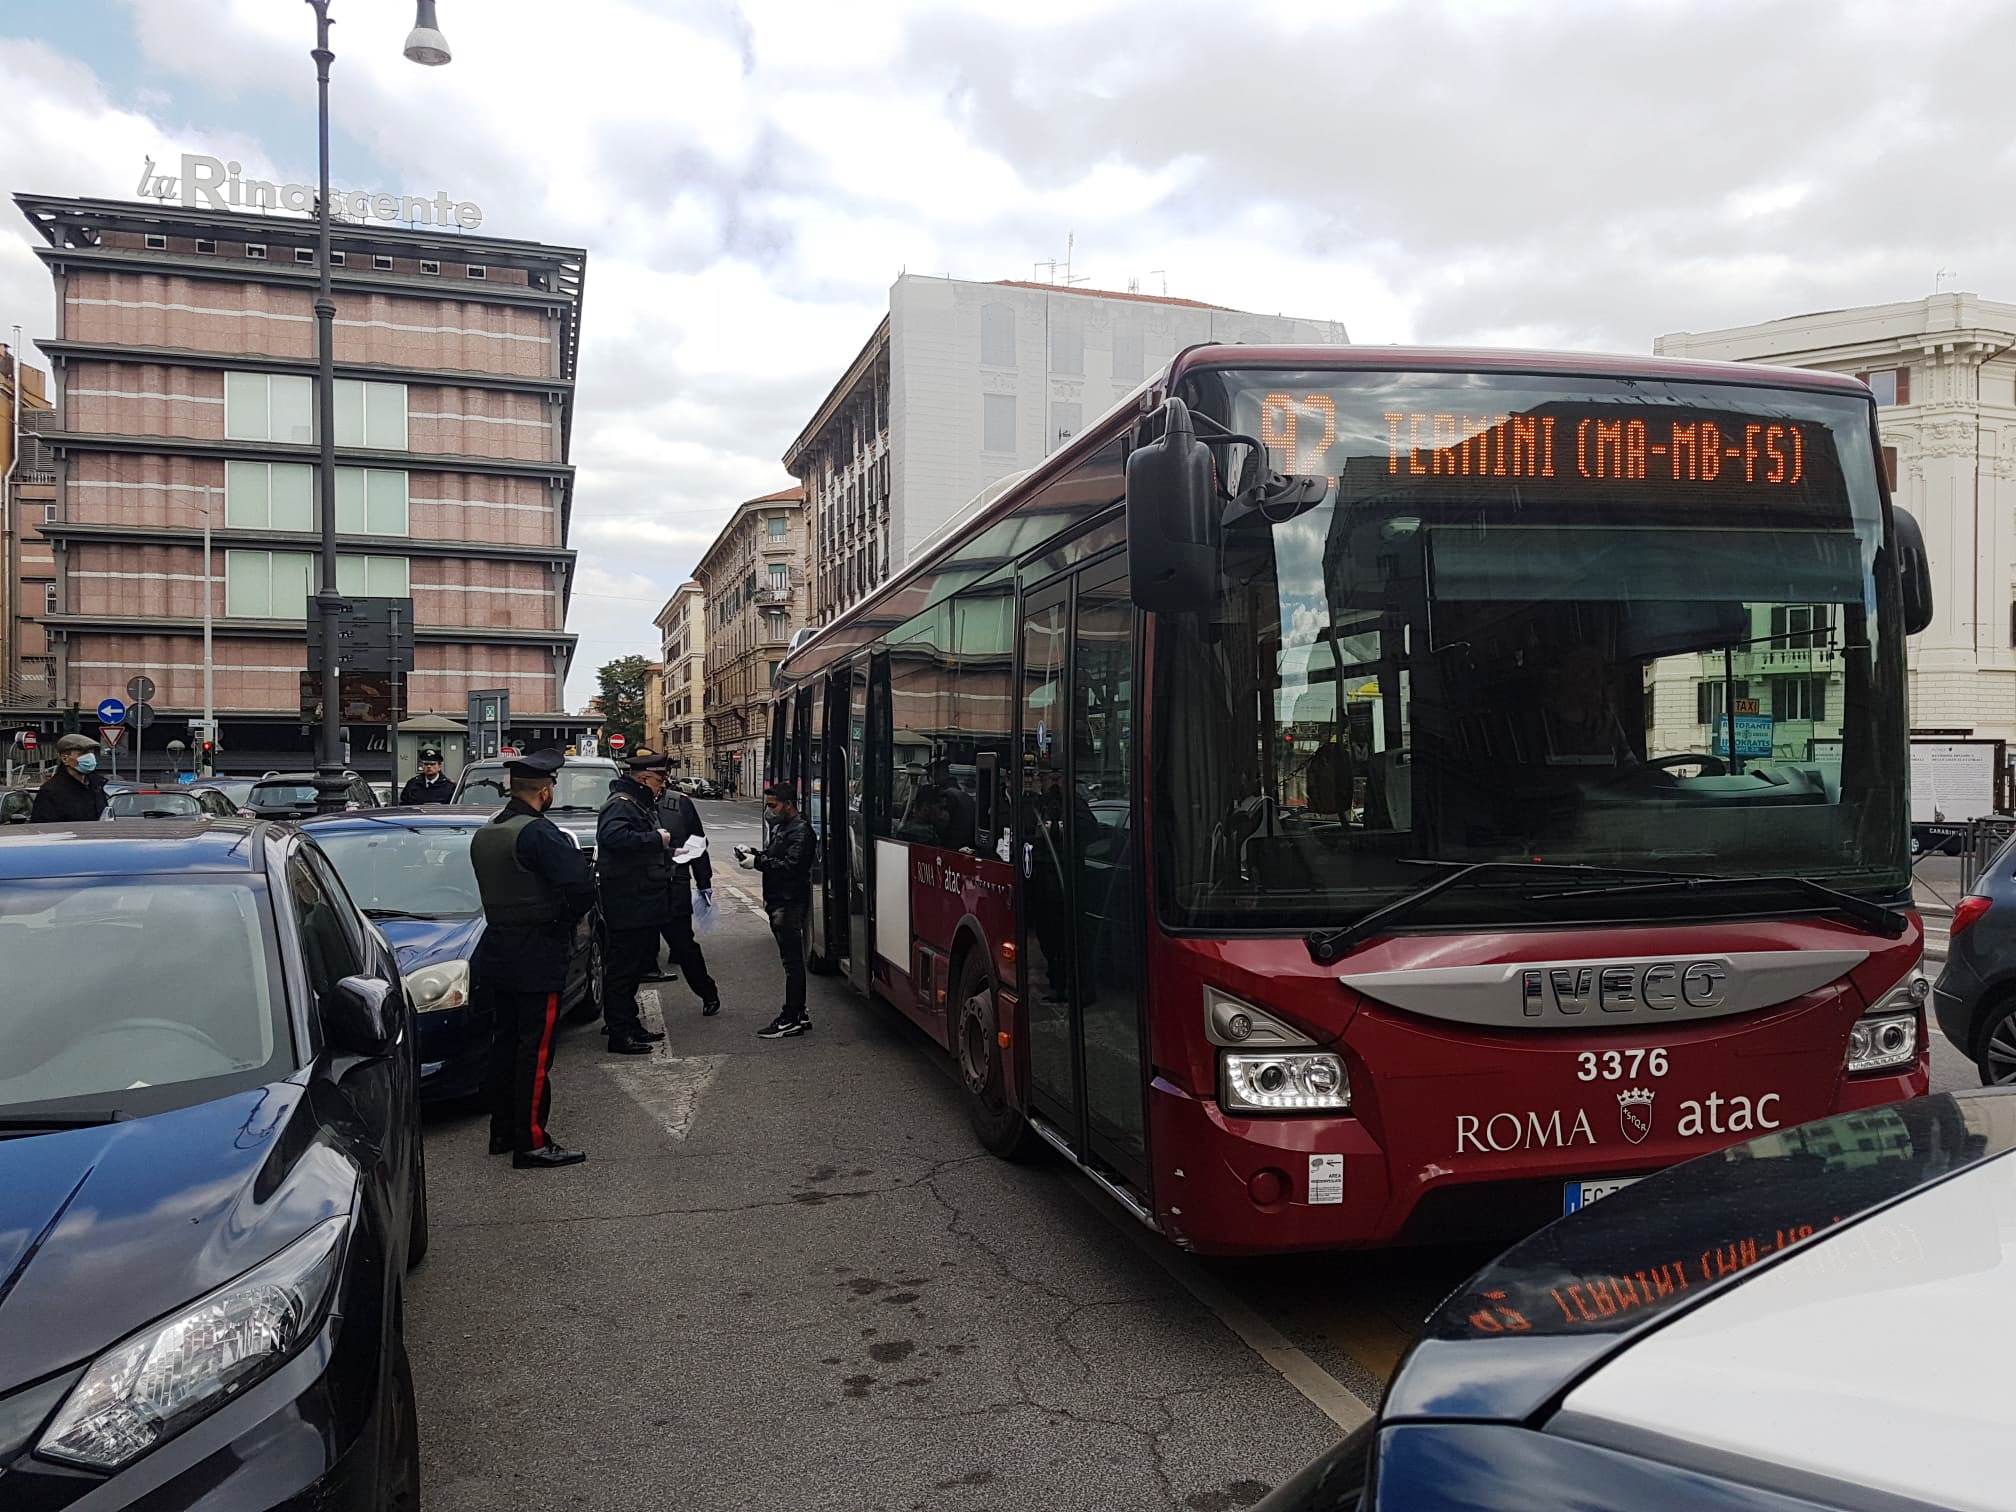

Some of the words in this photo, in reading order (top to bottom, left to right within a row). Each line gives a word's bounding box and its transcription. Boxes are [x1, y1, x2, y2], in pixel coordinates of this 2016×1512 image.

[137, 158, 177, 199] la
[181, 153, 483, 229] Rinascente
[1261, 393, 1336, 487] 92
[1383, 411, 1556, 478] TERMINI
[1576, 415, 1804, 486] (MA-MB-FS)
[1735, 700, 1758, 712] TAXI
[944, 866, 961, 895] atac
[1522, 962, 1727, 1017] IVECO
[1577, 1048, 1670, 1082] 3376
[1455, 1108, 1598, 1153] ROMA
[1626, 1111, 1647, 1131] SPQR
[1677, 1091, 1781, 1137] atac
